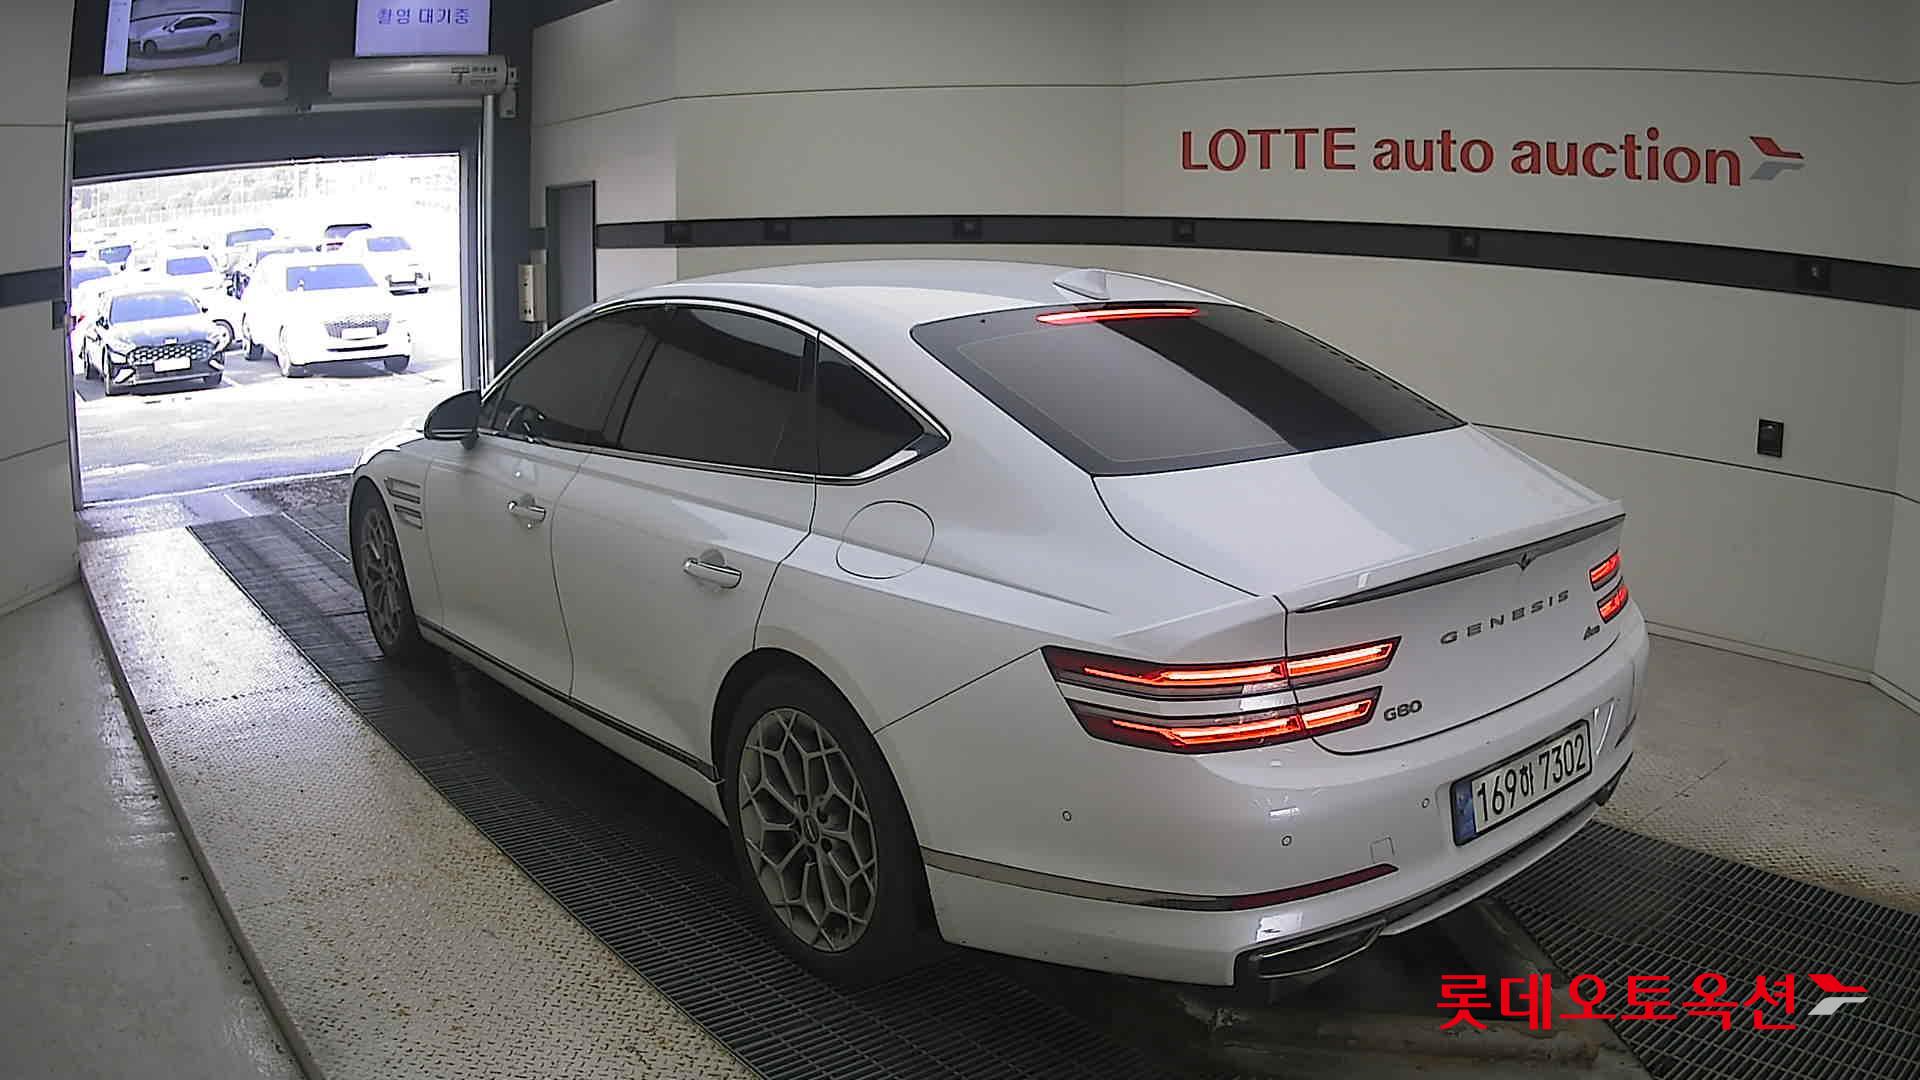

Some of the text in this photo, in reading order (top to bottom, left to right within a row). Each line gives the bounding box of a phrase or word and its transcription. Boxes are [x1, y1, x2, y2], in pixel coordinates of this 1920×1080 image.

[418, 8, 470, 25] 대기중
[1182, 127, 1742, 186] LOTTE auto auction
[1440, 589, 1569, 645] GENESIS
[1383, 699, 1423, 722] G80
[1538, 733, 1586, 790] 7302
